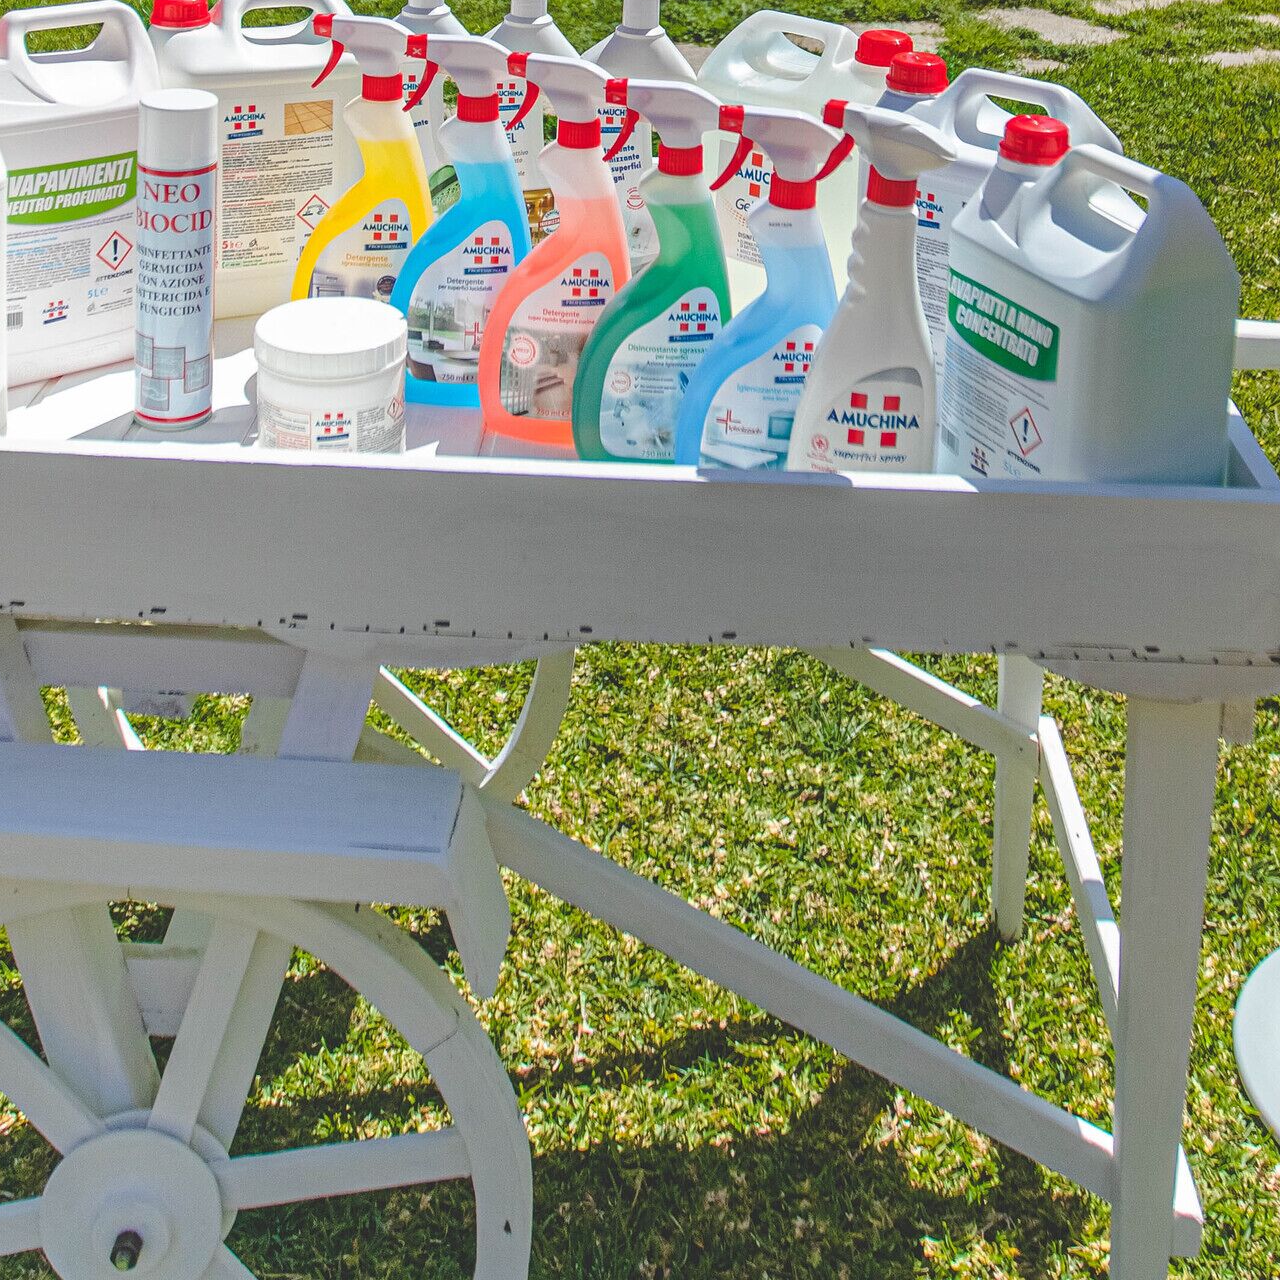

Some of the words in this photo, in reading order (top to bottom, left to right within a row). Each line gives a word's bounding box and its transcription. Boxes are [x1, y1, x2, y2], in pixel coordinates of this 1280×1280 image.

[224, 113, 266, 123] AMUCHINA
[8, 157, 134, 198] VAPAVIMENTI
[736, 168, 770, 184] AMUC
[55, 183, 127, 210] PROFUMATO
[143, 180, 200, 203] NEO
[362, 223, 408, 231] AMUCHINA
[346, 253, 388, 263] Detergente
[463, 247, 510, 255] AMUCHINA
[139, 260, 203, 275] GERMICIDA
[139, 273, 157, 287] CON
[159, 274, 205, 289] AZIONE
[447, 277, 484, 286] Detergente
[561, 278, 609, 287] AMUCHINA
[139, 302, 202, 317] FUNGICIDA
[543, 309, 580, 318] Detergente
[668, 313, 718, 322] AMUCHINA
[956, 303, 1039, 367] CONCENTRATO
[1015, 311, 1053, 349] MANO
[628, 344, 678, 354] Disincrostante
[680, 347, 705, 355] sgrassa
[827, 409, 919, 429] AMUCHINA
[833, 448, 877, 462] superfici
[880, 454, 908, 464] spray
